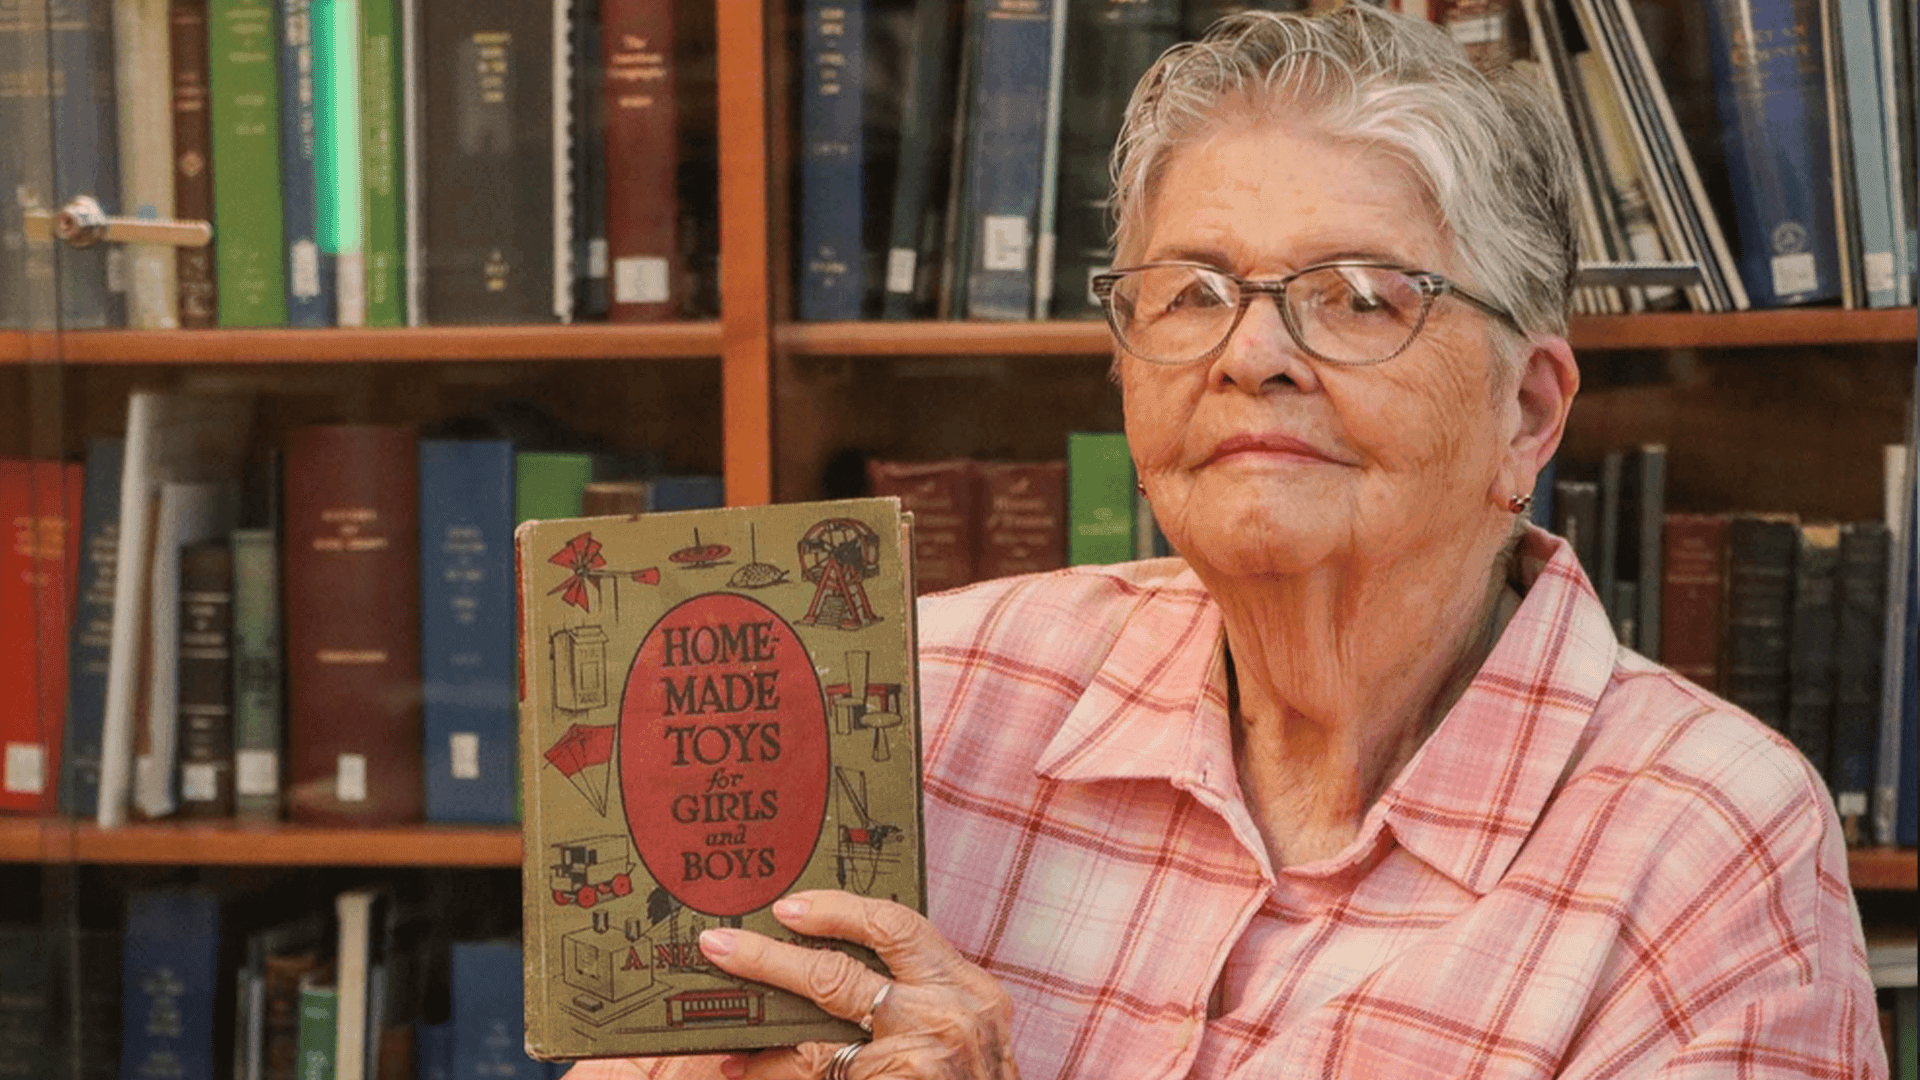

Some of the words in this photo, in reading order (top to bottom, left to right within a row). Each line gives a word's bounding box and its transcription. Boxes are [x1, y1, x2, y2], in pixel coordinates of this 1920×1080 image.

[661, 619, 780, 667] HOME-
[660, 669, 780, 716] MADE
[663, 721, 781, 766] TOYS
[706, 767, 744, 792] for
[671, 789, 779, 824] GIRLS
[705, 823, 747, 847] and
[681, 846, 776, 881] BOYS
